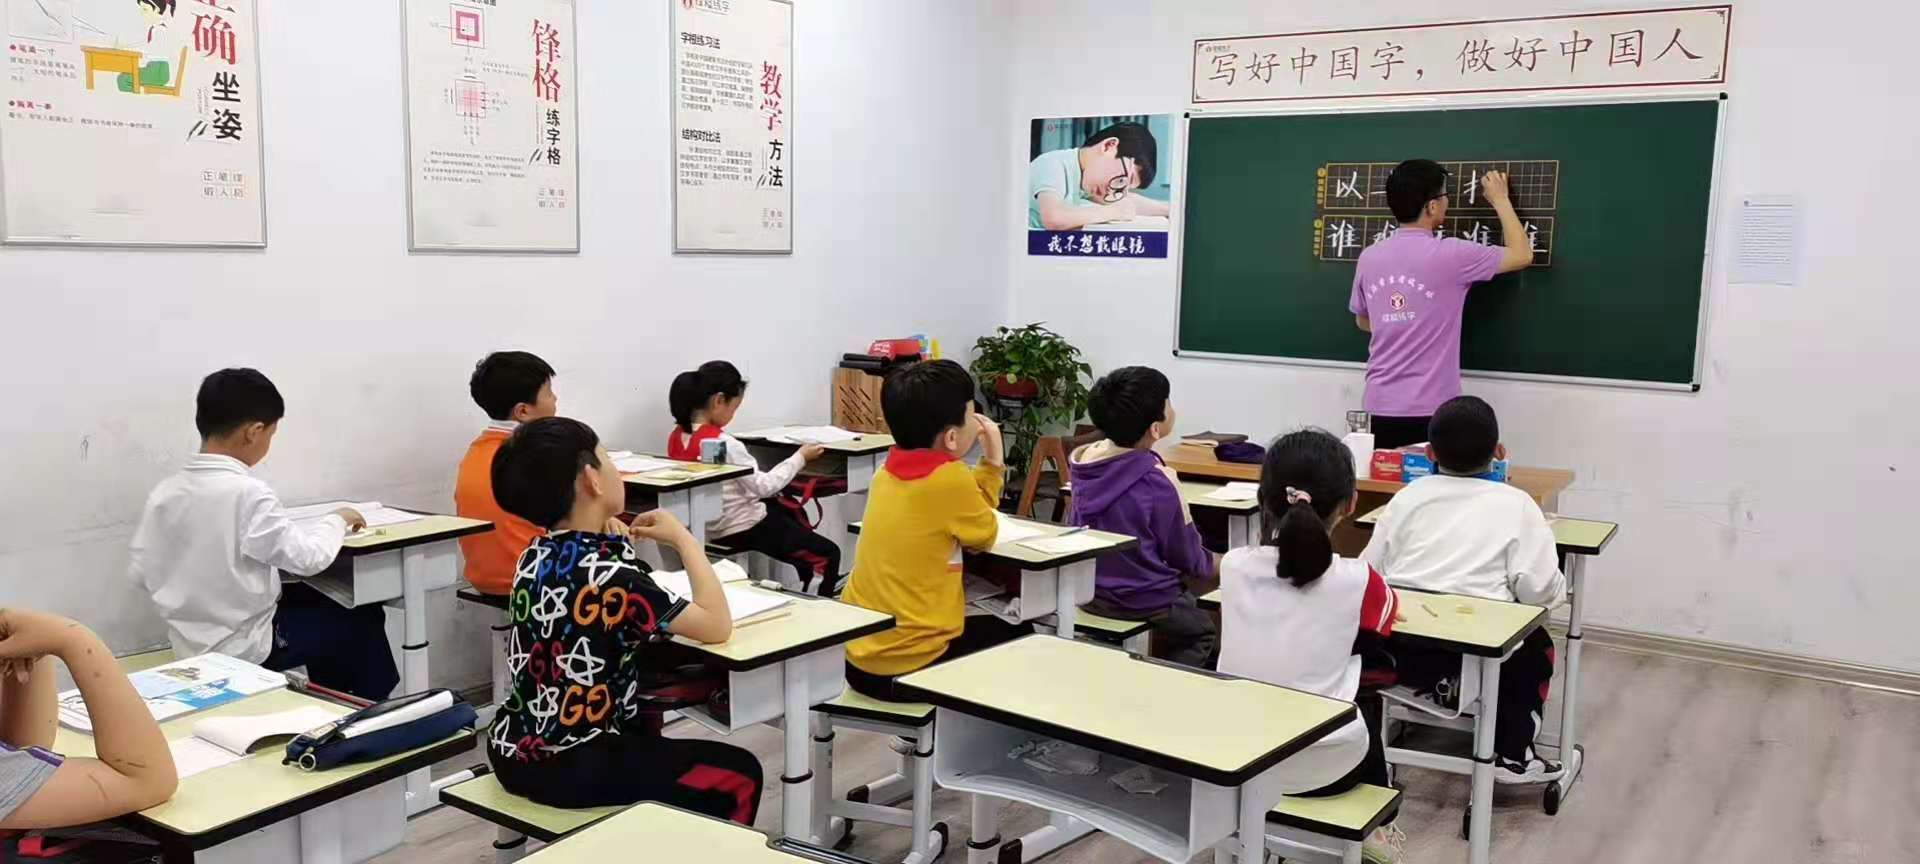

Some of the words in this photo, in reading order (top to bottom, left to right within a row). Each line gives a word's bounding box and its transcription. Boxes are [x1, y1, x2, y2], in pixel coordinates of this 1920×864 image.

[532, 18, 562, 104] 锋格
[1209, 28, 1704, 86] 写好中国字，做好中国人
[212, 71, 243, 141] 坐姿
[760, 60, 783, 132] 教学
[546, 107, 562, 166] 练字格
[681, 127, 721, 143] 结构对比法
[768, 139, 784, 188] 方法
[1336, 170, 1364, 200] 以
[1048, 234, 1145, 254] 我不想戴眼镜
